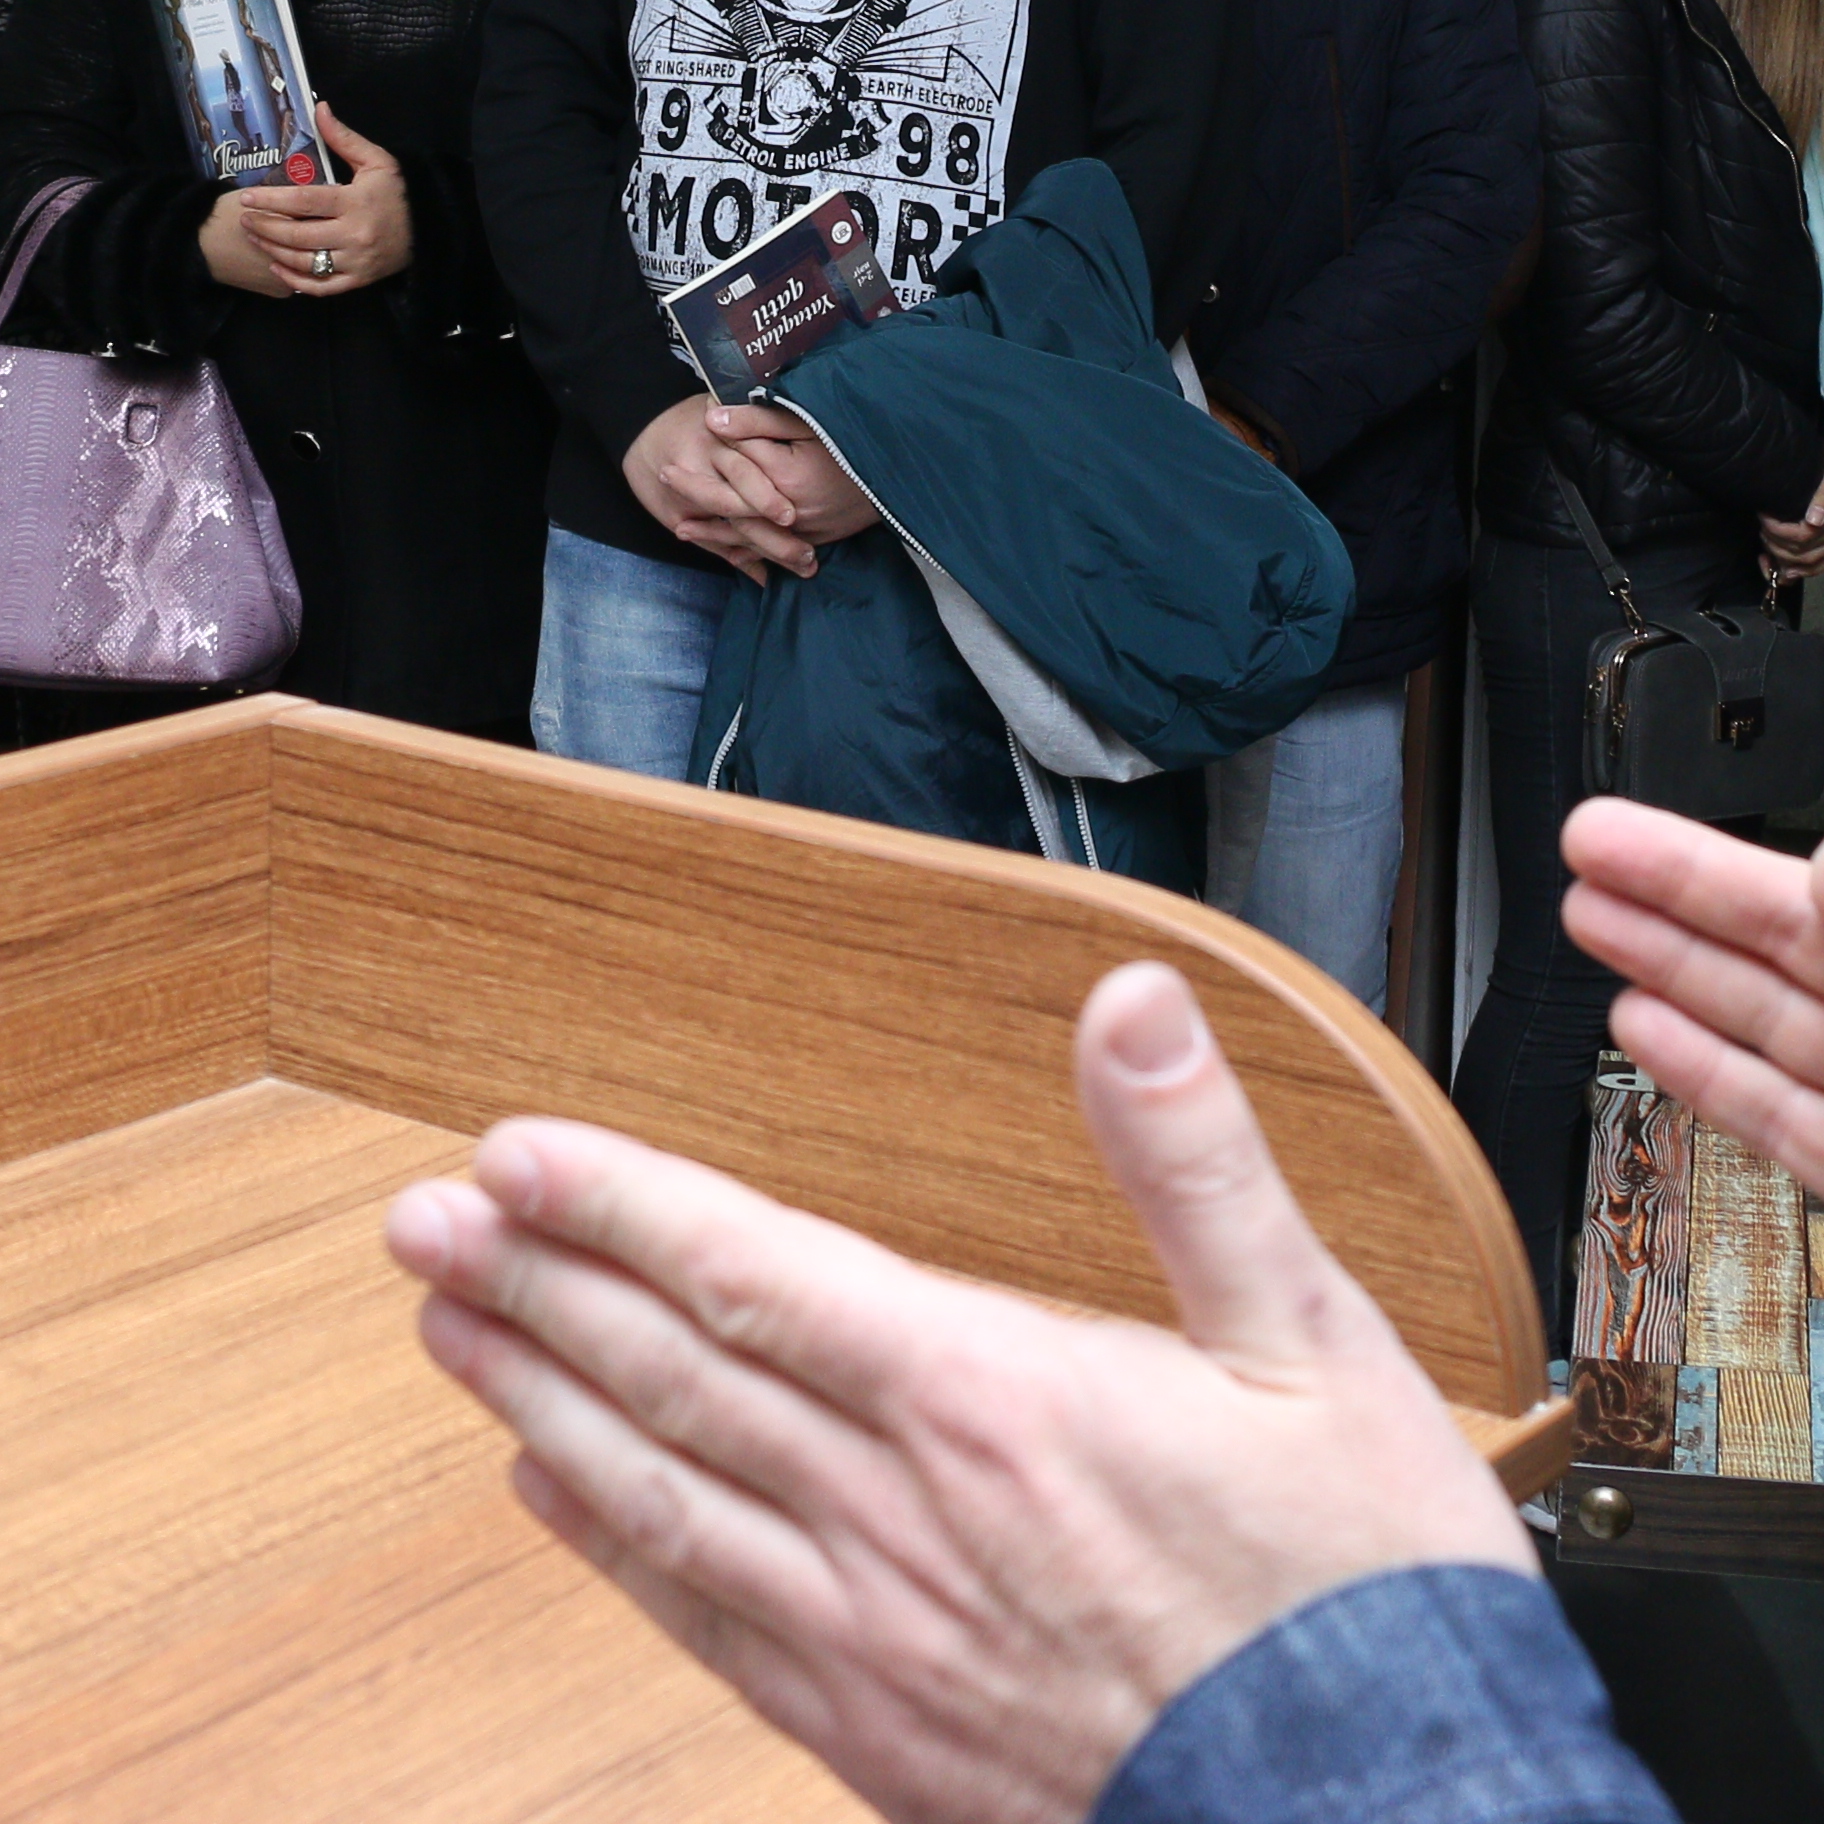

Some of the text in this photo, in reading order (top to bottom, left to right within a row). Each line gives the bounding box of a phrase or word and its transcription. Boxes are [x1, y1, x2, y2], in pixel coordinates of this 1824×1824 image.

[654, 61, 736, 78] RING-SHAPED
[723, 127, 851, 170] PETROL ENGINE
[895, 112, 981, 186] 98
[744, 293, 837, 357] Yataqdakı
[750, 277, 806, 333] qatil
